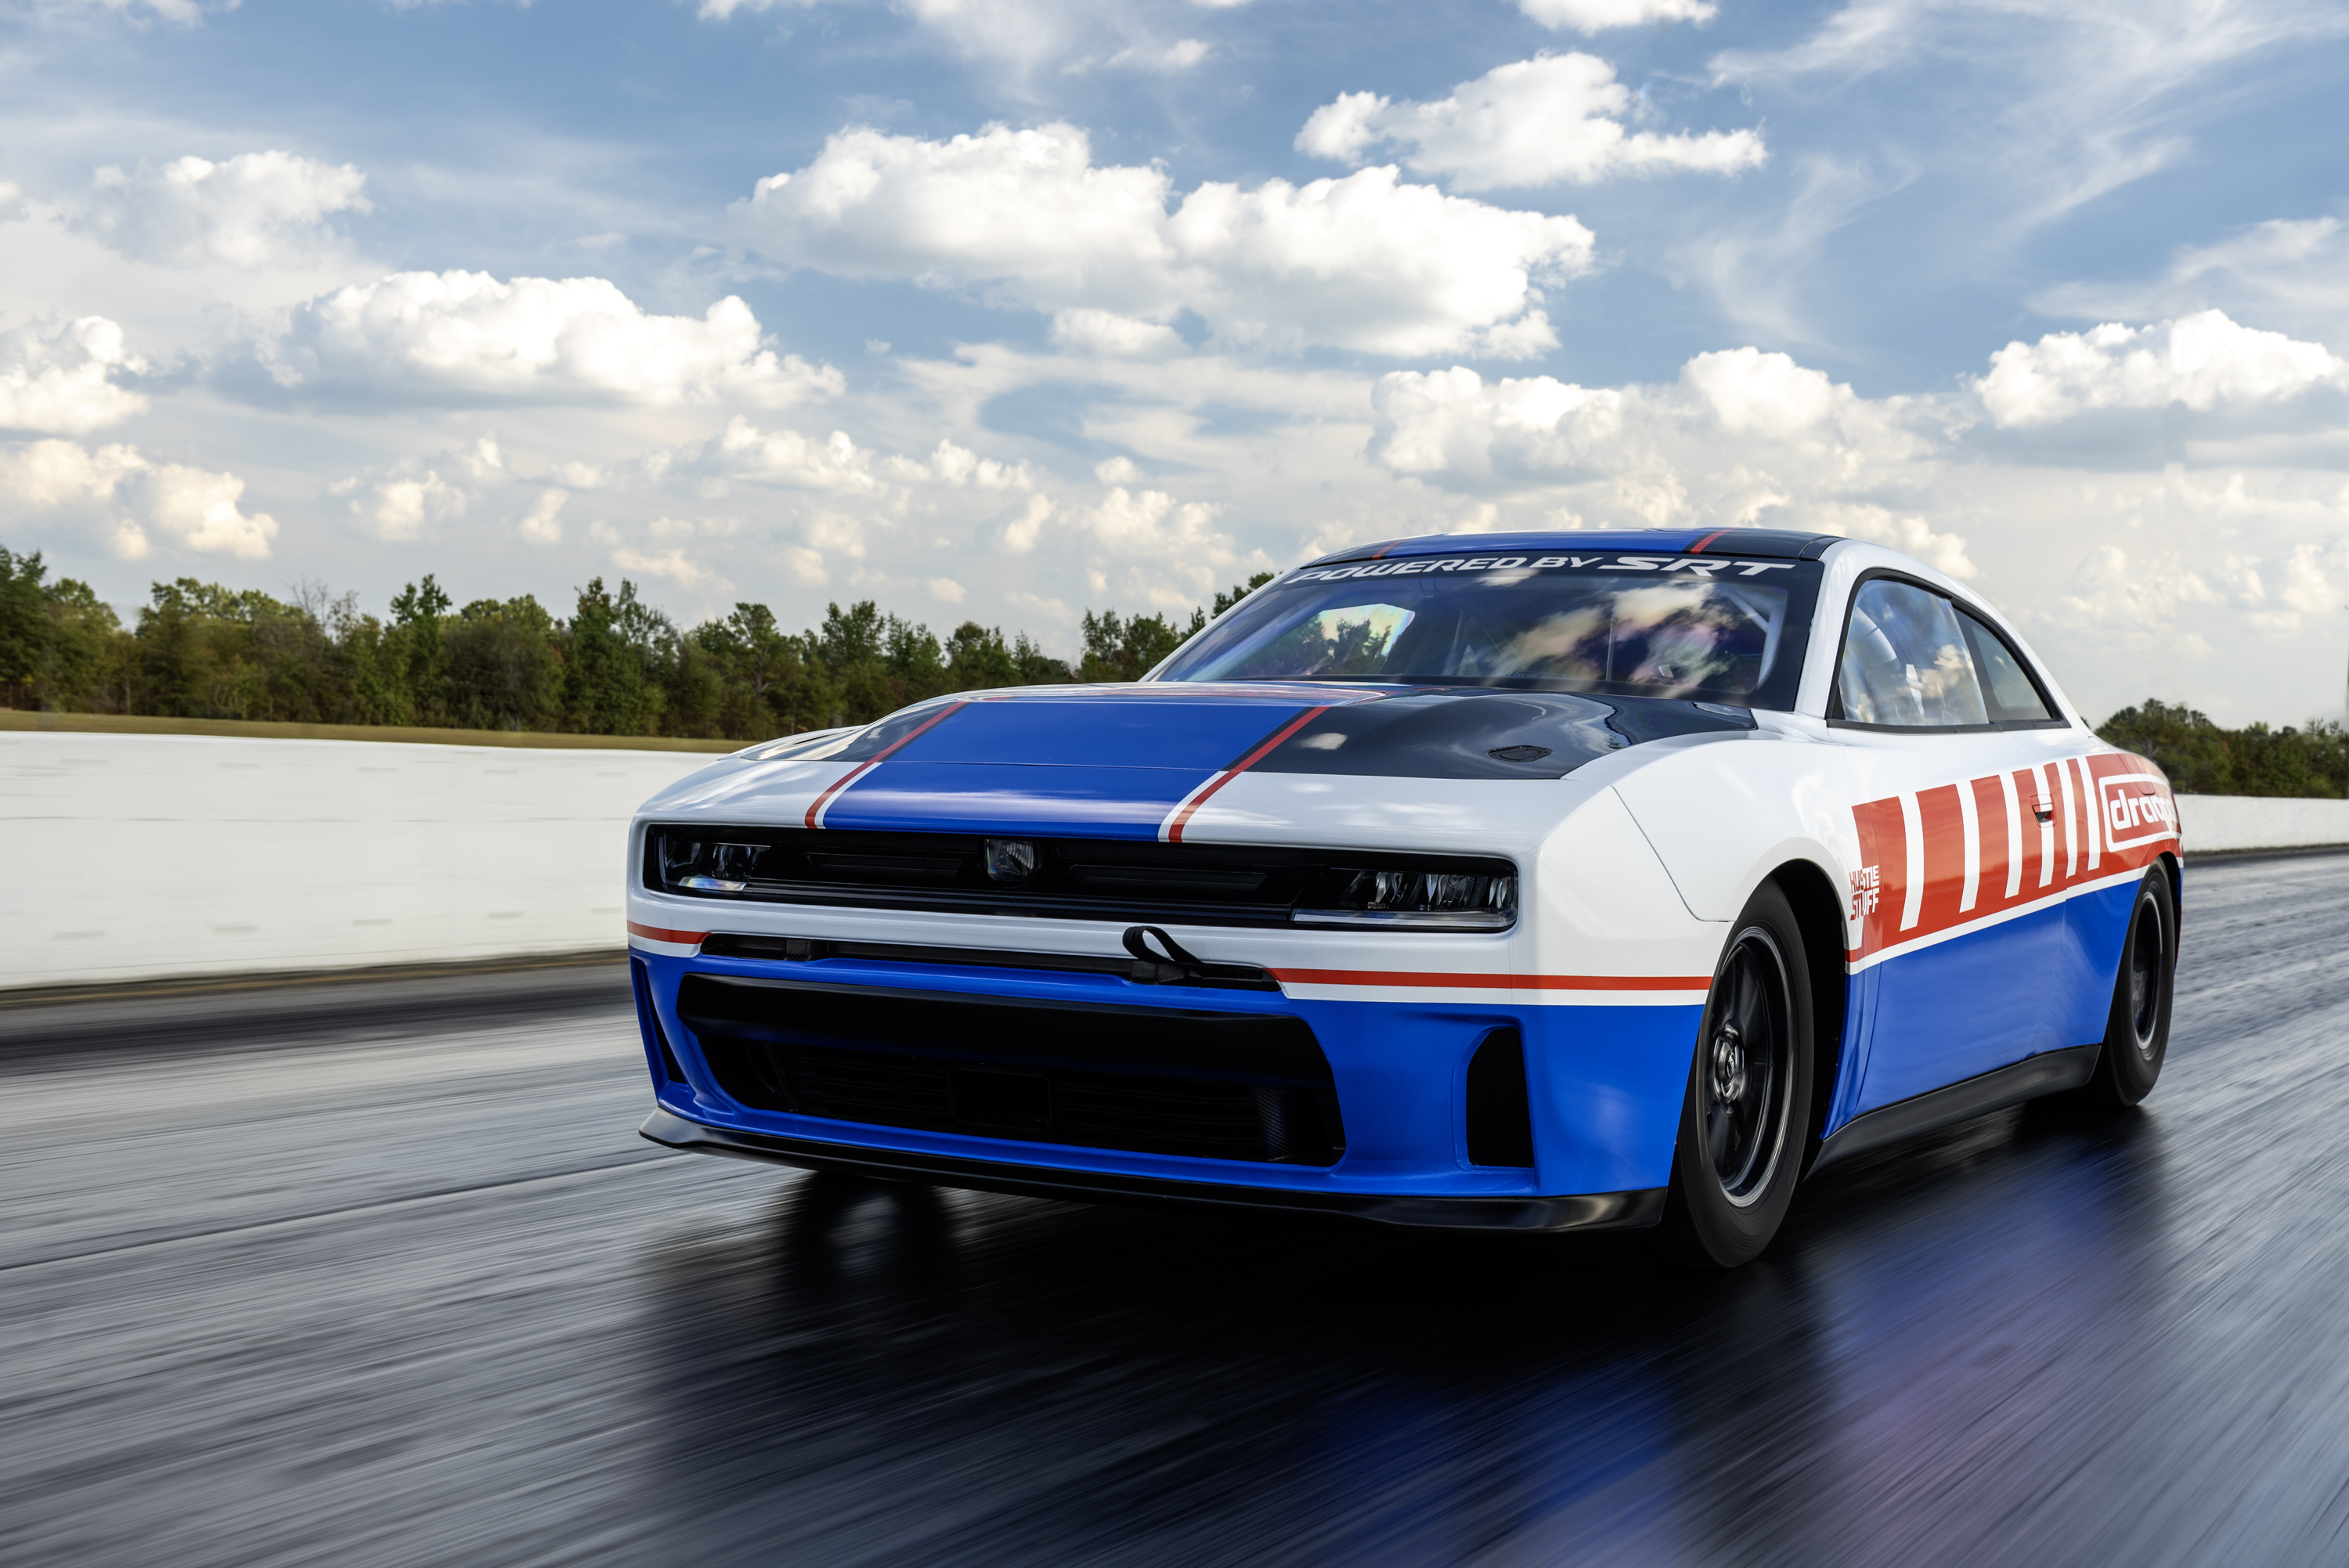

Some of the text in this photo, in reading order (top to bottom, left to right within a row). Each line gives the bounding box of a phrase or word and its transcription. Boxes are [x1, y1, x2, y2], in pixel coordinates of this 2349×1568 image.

[1283, 557, 1796, 585] POWERED BY SRT
[1849, 865, 1880, 894] HUSTLE
[1849, 887, 1880, 921] STUFF
